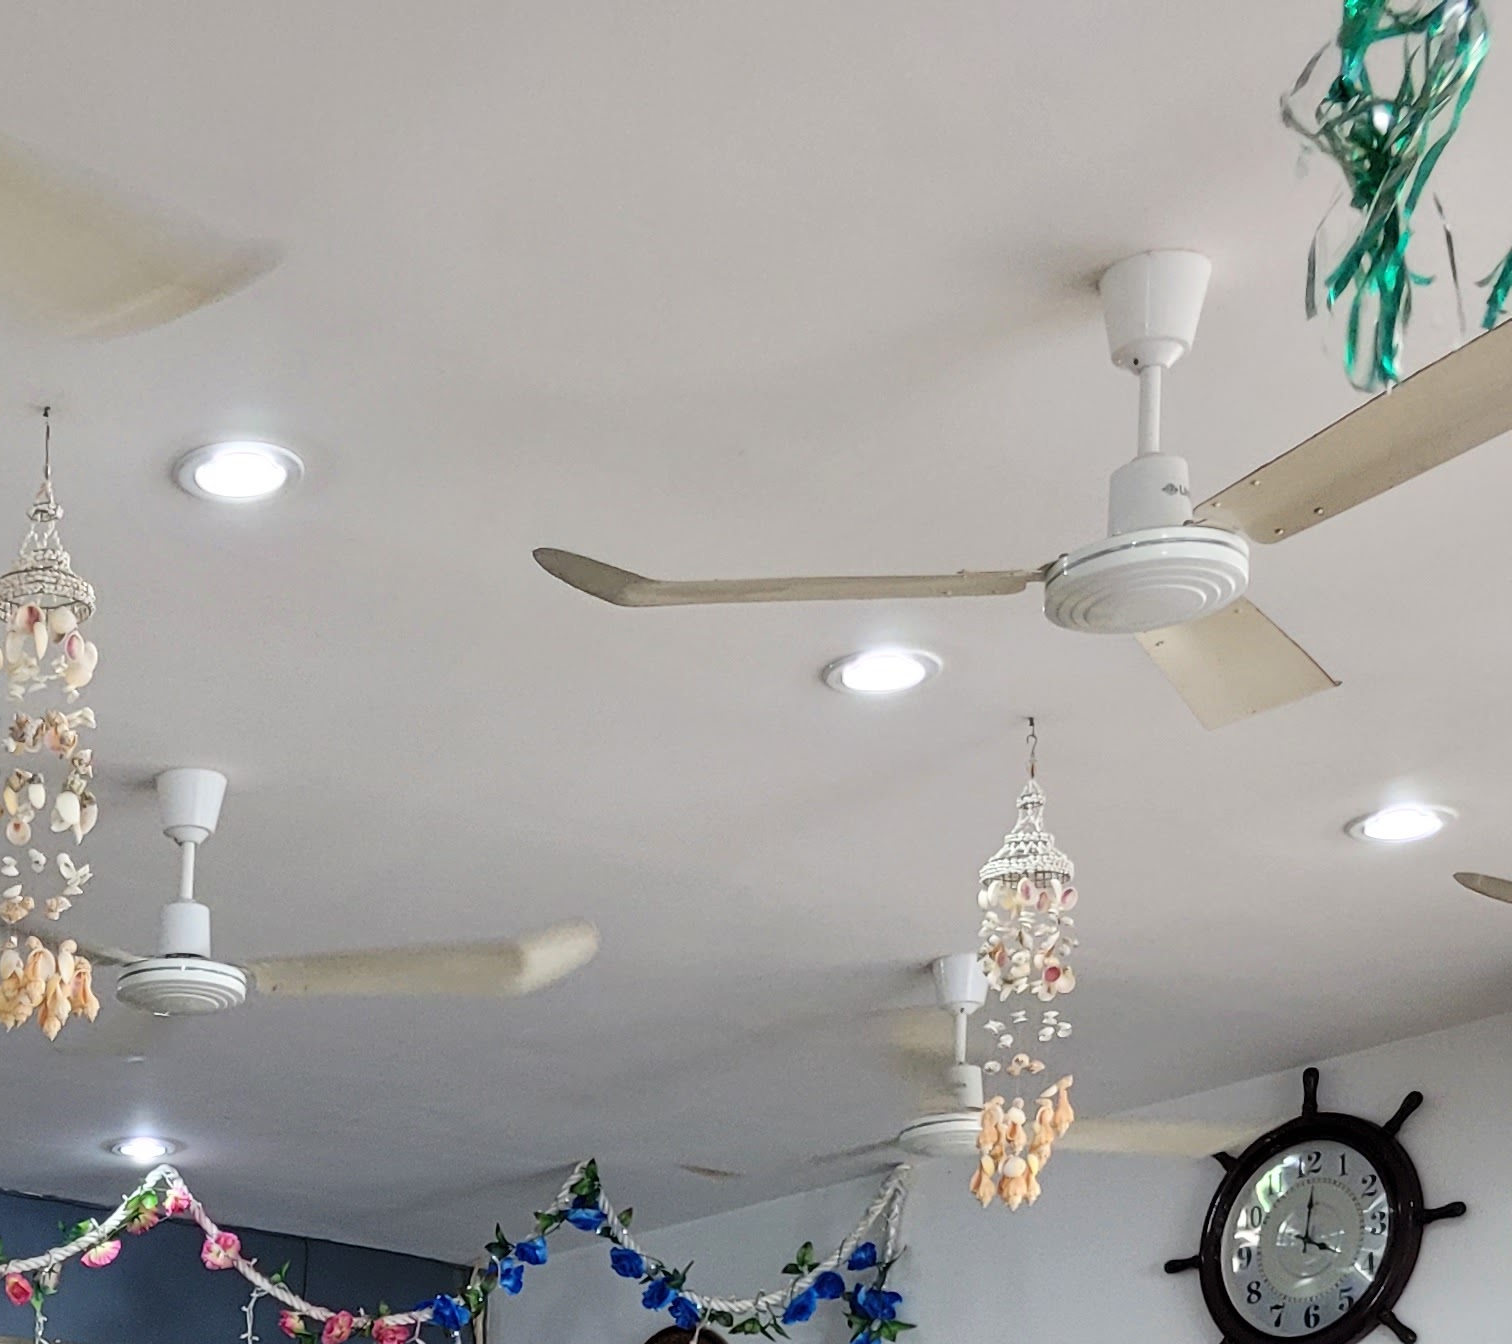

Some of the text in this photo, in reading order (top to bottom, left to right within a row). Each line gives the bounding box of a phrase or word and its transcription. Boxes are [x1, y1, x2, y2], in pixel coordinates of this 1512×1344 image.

[1297, 1151, 1322, 1178] 12
[1339, 1154, 1348, 1176] 1
[1361, 1174, 1377, 1197] 2
[1370, 1211, 1387, 1235] 3
[1237, 1247, 1252, 1269] 9
[1362, 1251, 1374, 1275] 4
[1246, 1281, 1262, 1304] 8
[1338, 1286, 1354, 1312] 5
[1270, 1303, 1284, 1327] 7
[1303, 1304, 1320, 1328] 6
